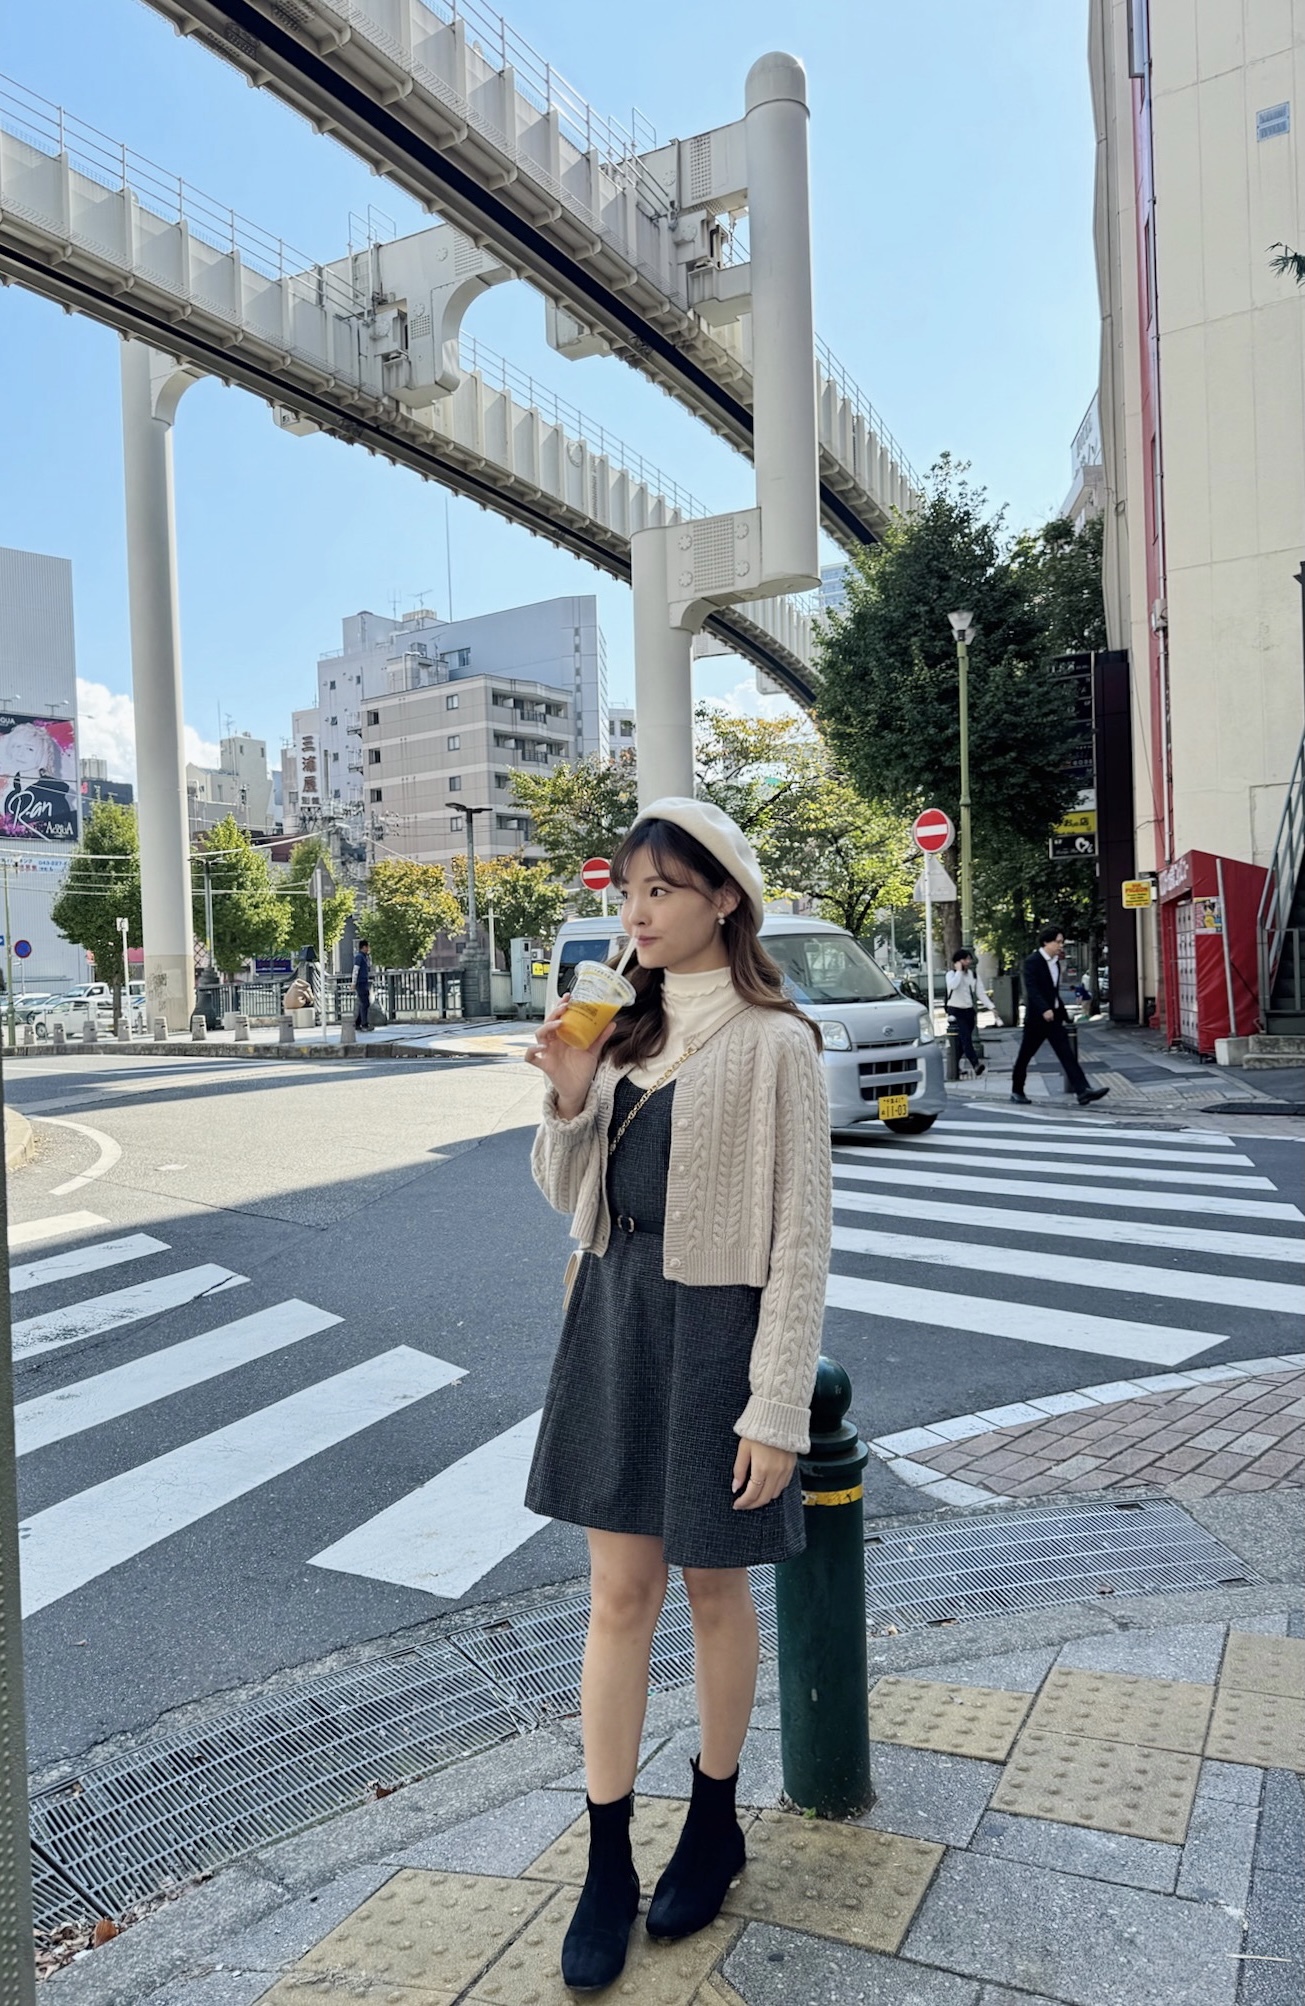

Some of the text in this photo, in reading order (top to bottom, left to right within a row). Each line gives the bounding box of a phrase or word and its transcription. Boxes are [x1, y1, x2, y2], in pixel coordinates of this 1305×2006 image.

[301, 735, 318, 793] 三浦屋
[886, 1104, 907, 1117] 11-03
